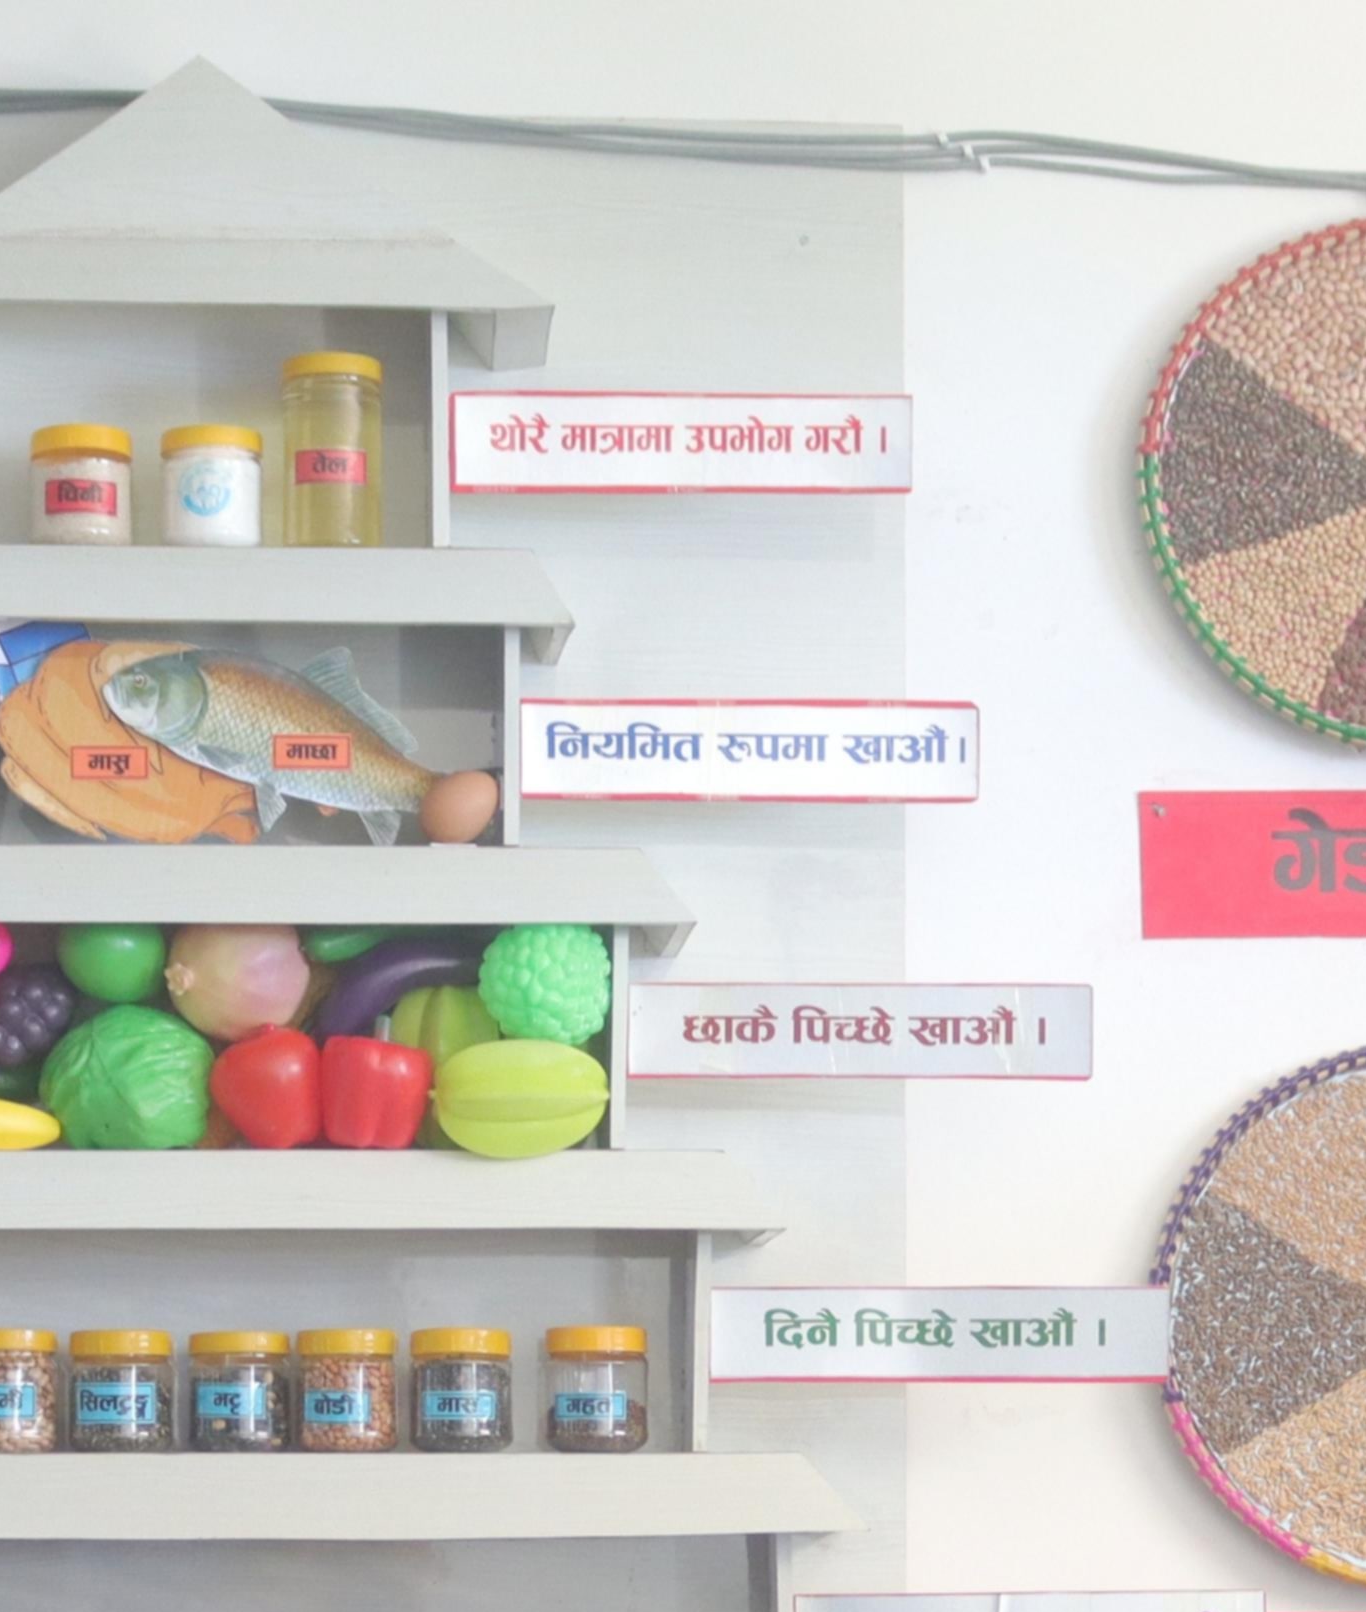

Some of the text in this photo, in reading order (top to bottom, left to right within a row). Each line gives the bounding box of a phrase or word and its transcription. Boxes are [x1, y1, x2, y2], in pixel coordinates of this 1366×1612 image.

[490, 414, 550, 455] थोरै
[561, 423, 674, 455] मात्रामा
[685, 415, 794, 455] उपभोग
[285, 740, 338, 762] माछा
[545, 721, 703, 762] नियमित
[87, 752, 132, 775] मासु
[682, 1003, 779, 1044] छाकै
[791, 1004, 894, 1046] पिच्छे
[764, 1308, 841, 1349] दिनै
[854, 1308, 957, 1349] पिच्छे
